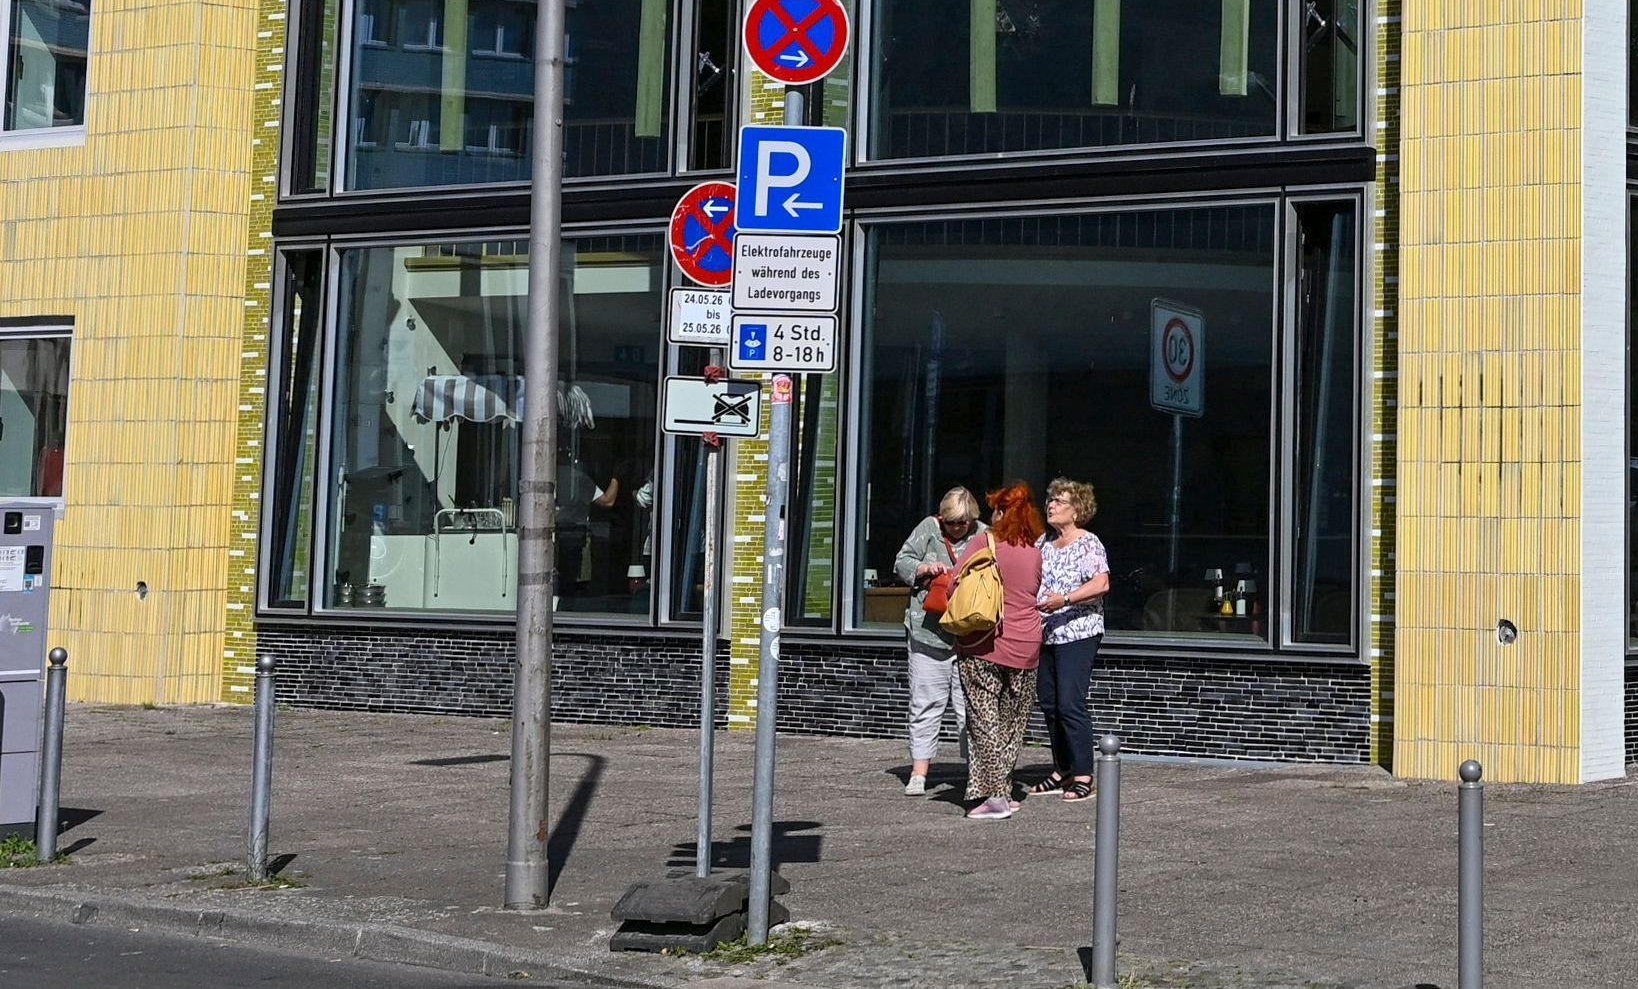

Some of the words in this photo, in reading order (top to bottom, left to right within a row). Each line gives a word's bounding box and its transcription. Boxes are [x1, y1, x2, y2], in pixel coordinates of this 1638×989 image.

[755, 140, 811, 217] P
[741, 245, 832, 261] Elektrofahrzeuge
[751, 266, 797, 279] während
[801, 267, 820, 279] des
[684, 293, 723, 305] 24.05.26
[748, 286, 821, 302] Ladevorgangs
[706, 310, 721, 319] bis
[682, 323, 721, 334] 25.05.26
[774, 324, 785, 340] 4
[791, 325, 826, 341] Std.
